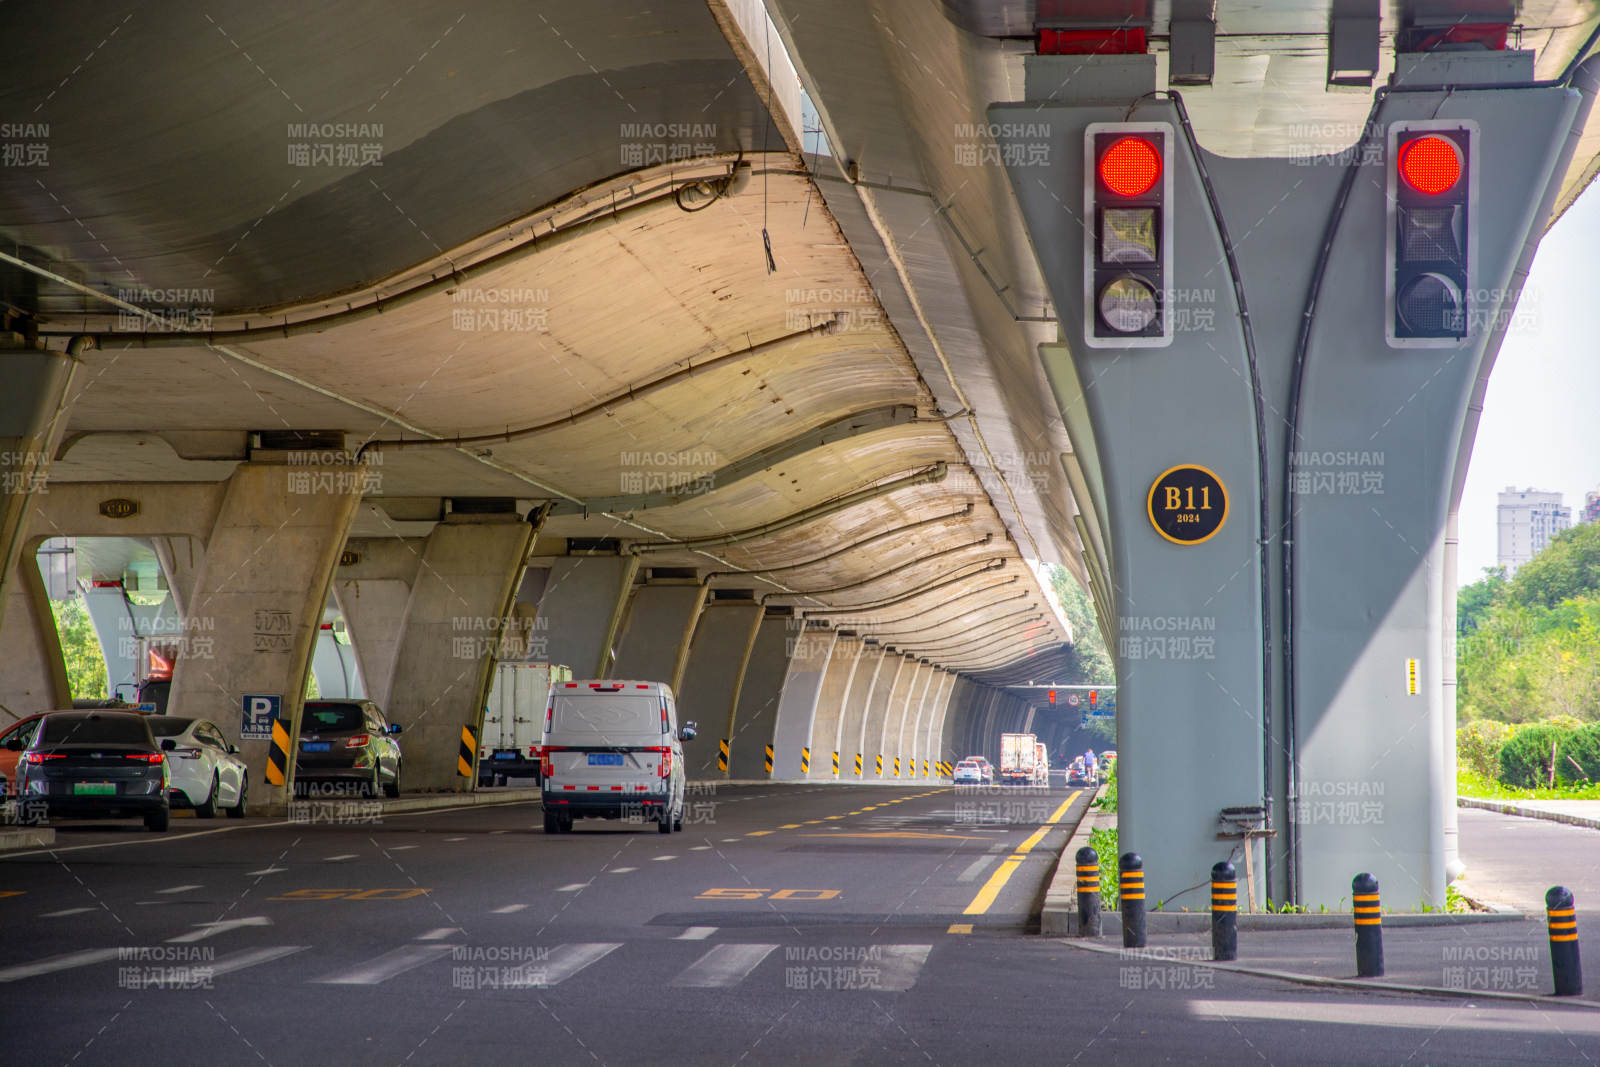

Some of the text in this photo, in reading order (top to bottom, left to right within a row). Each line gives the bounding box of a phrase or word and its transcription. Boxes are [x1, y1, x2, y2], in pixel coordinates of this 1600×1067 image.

[1164, 486, 1212, 510] B11
[1177, 513, 1200, 523] 2024
[250, 697, 272, 724] P
[267, 888, 432, 900] 50
[694, 888, 842, 900] 50
